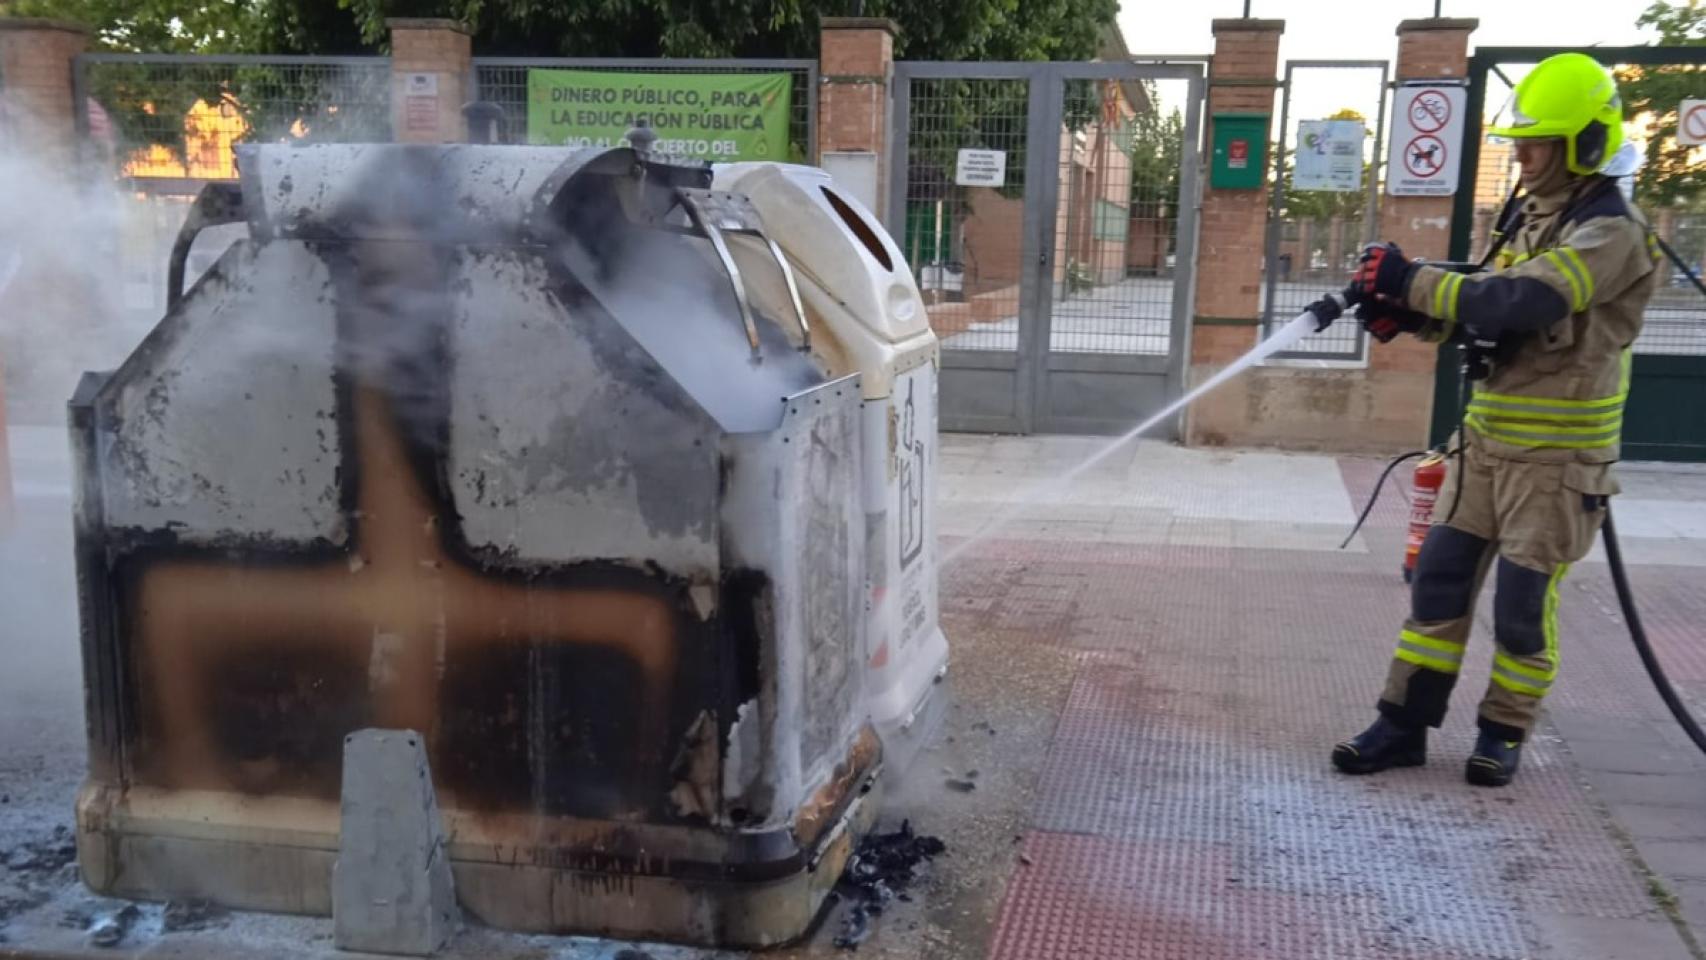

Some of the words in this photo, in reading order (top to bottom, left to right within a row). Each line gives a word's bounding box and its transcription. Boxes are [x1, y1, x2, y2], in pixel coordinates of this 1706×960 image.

[552, 87, 617, 104] DINERO
[622, 84, 704, 107] PÚBLICO,
[710, 90, 762, 107] PARA
[551, 109, 573, 126] LA
[688, 108, 765, 130] PÚBLICA
[712, 140, 740, 155] DEL
